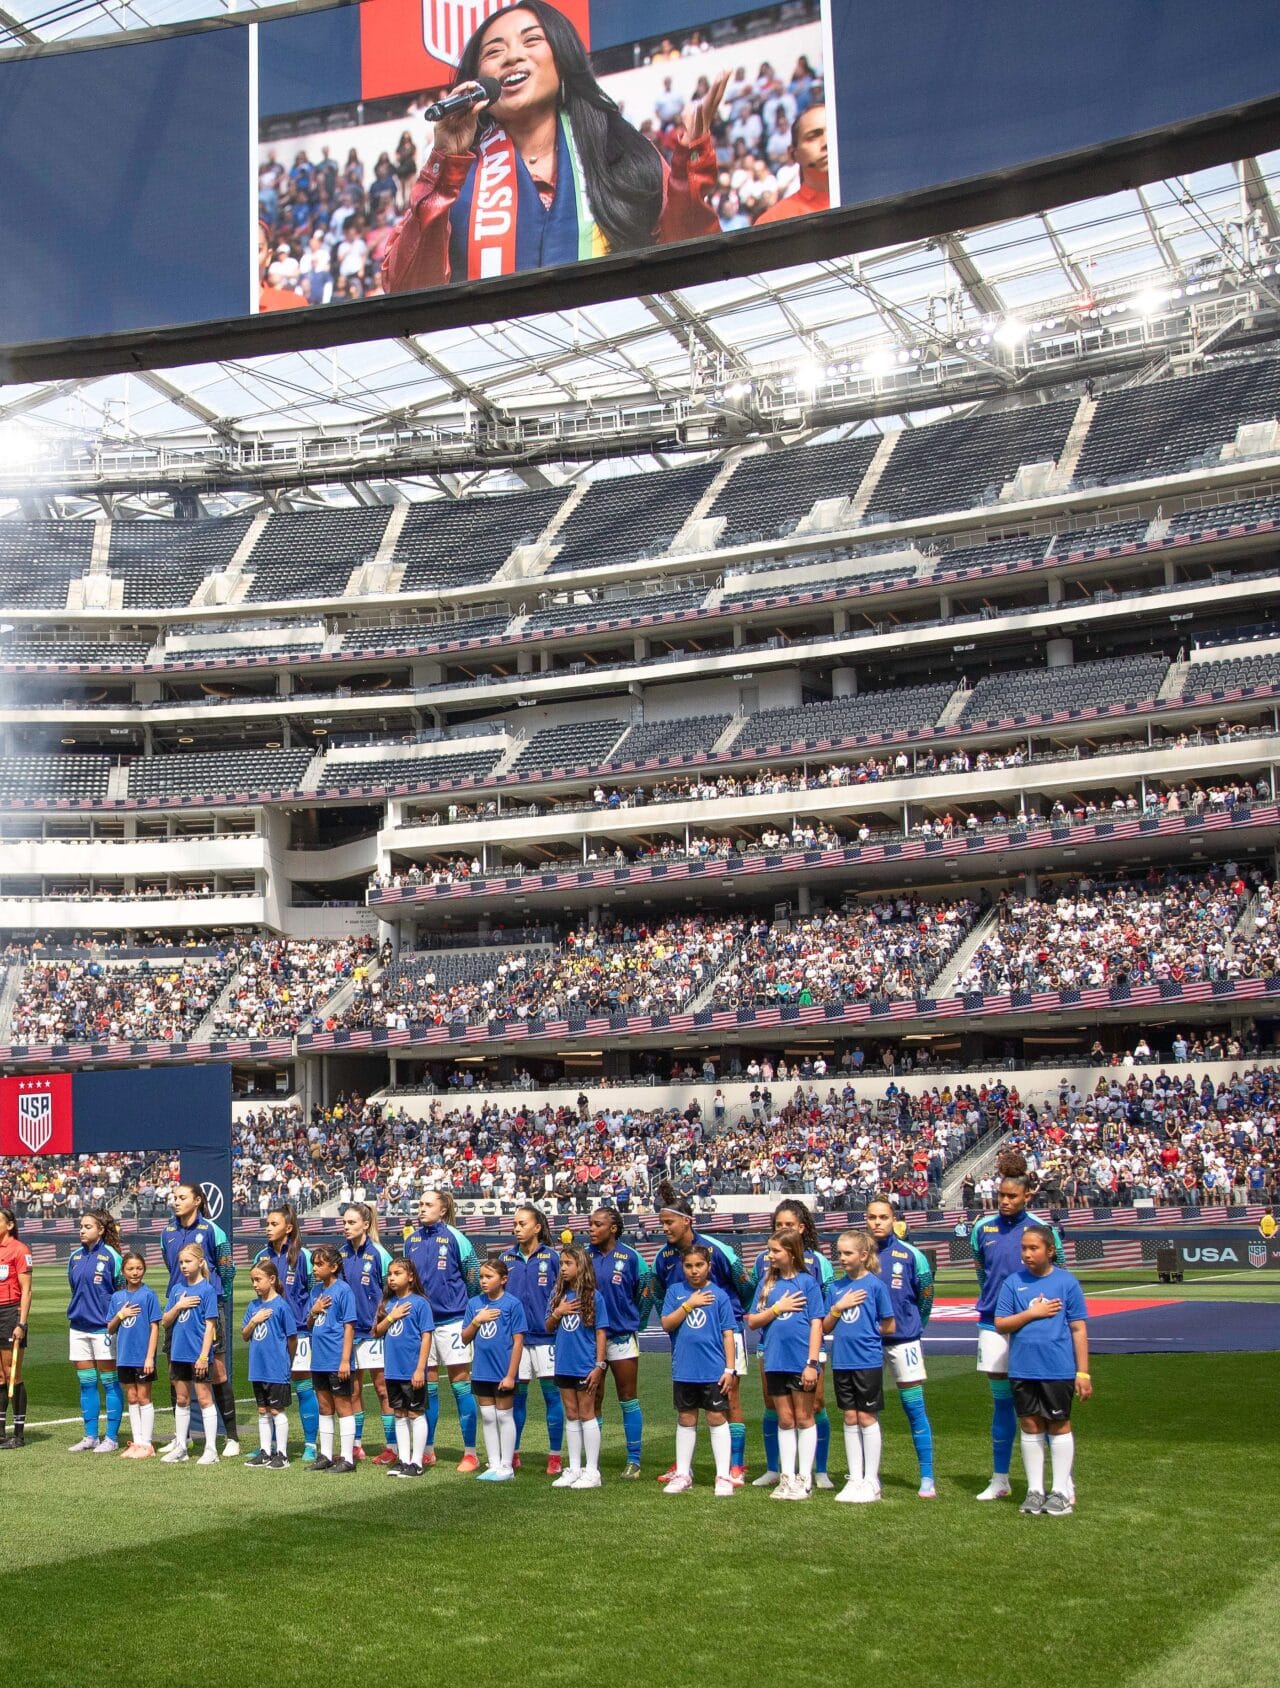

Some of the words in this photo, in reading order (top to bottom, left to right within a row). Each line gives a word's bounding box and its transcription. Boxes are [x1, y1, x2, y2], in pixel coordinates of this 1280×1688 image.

[21, 1096, 49, 1119] USA
[1182, 1247, 1239, 1262] USA
[905, 1346, 919, 1367] 18
